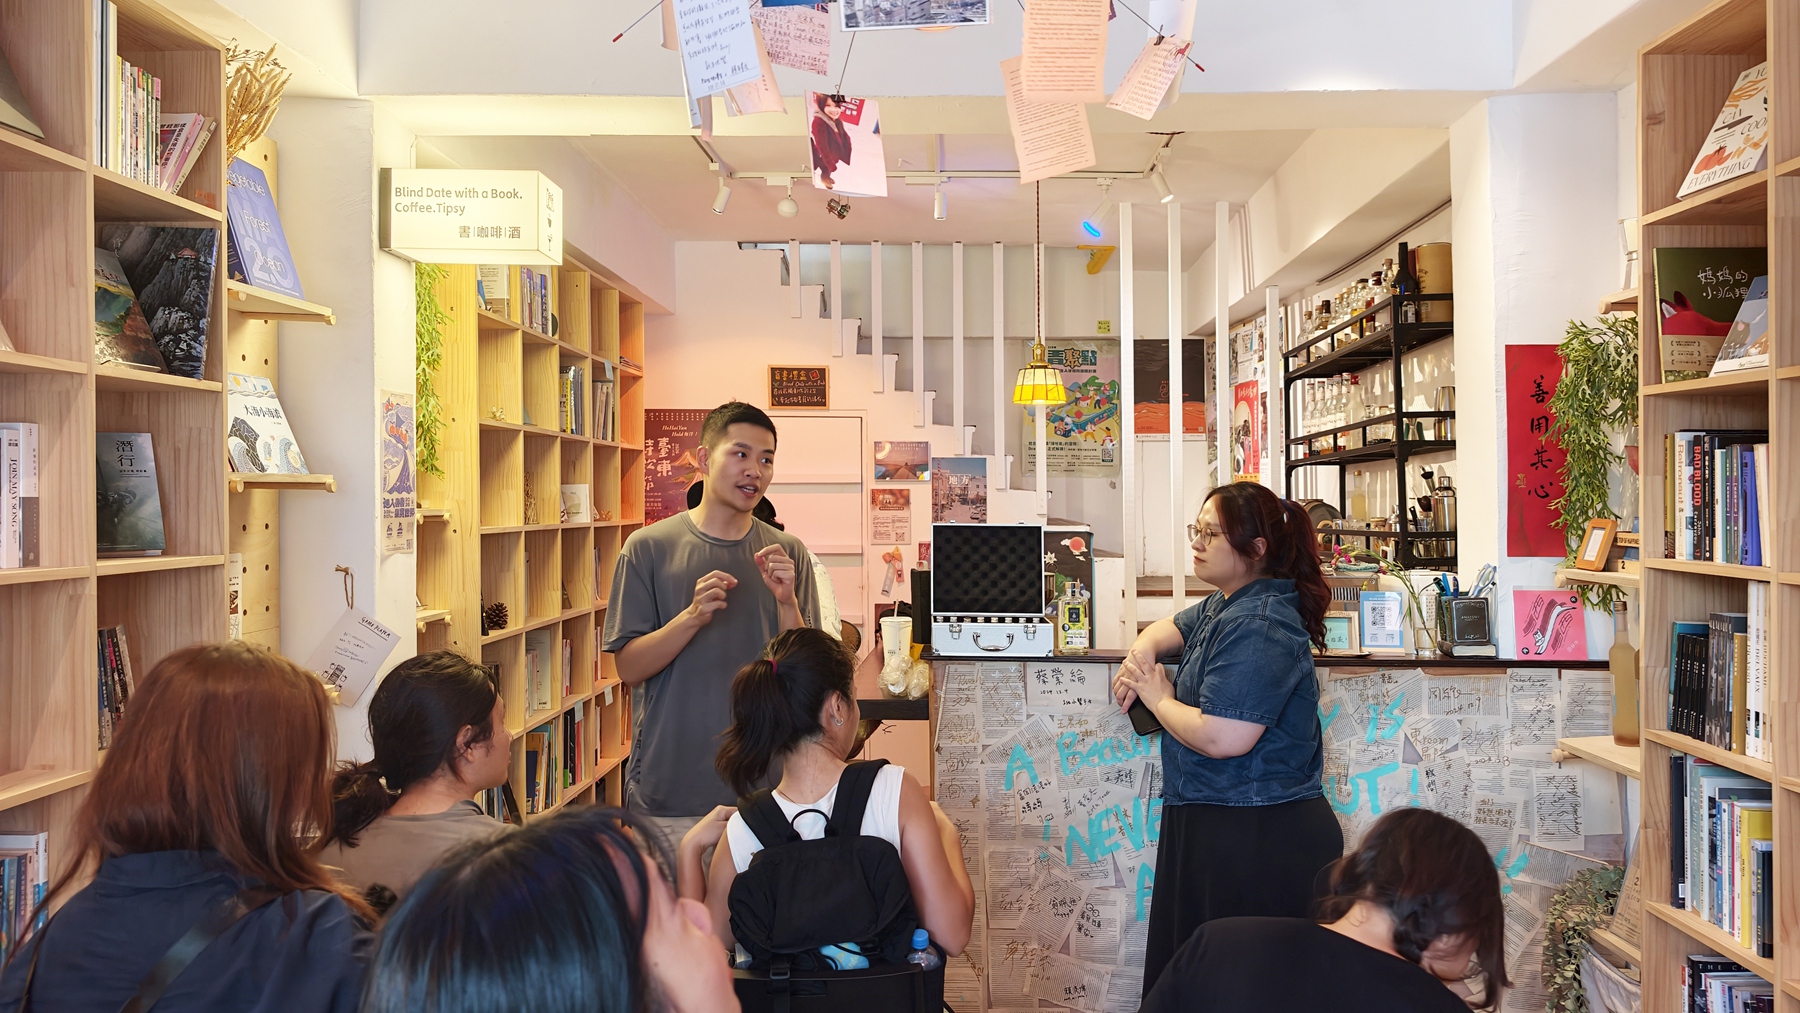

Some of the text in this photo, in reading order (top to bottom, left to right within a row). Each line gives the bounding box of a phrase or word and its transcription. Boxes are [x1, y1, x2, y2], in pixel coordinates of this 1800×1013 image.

[1686, 157, 1753, 190] EVERYTHING
[395, 187, 523, 199] Blind Date with a Book.
[1697, 265, 1748, 285] 媽媽的
[1702, 286, 1749, 299] 小狐狸
[1527, 374, 1554, 500] 善用其心
[656, 436, 673, 477] 臺東
[948, 475, 970, 486] 地方
[1693, 445, 1702, 506] BAD BLOOD
[1004, 743, 1039, 792] A
[1365, 691, 1406, 745] IS
[1698, 963, 1722, 971] THE
